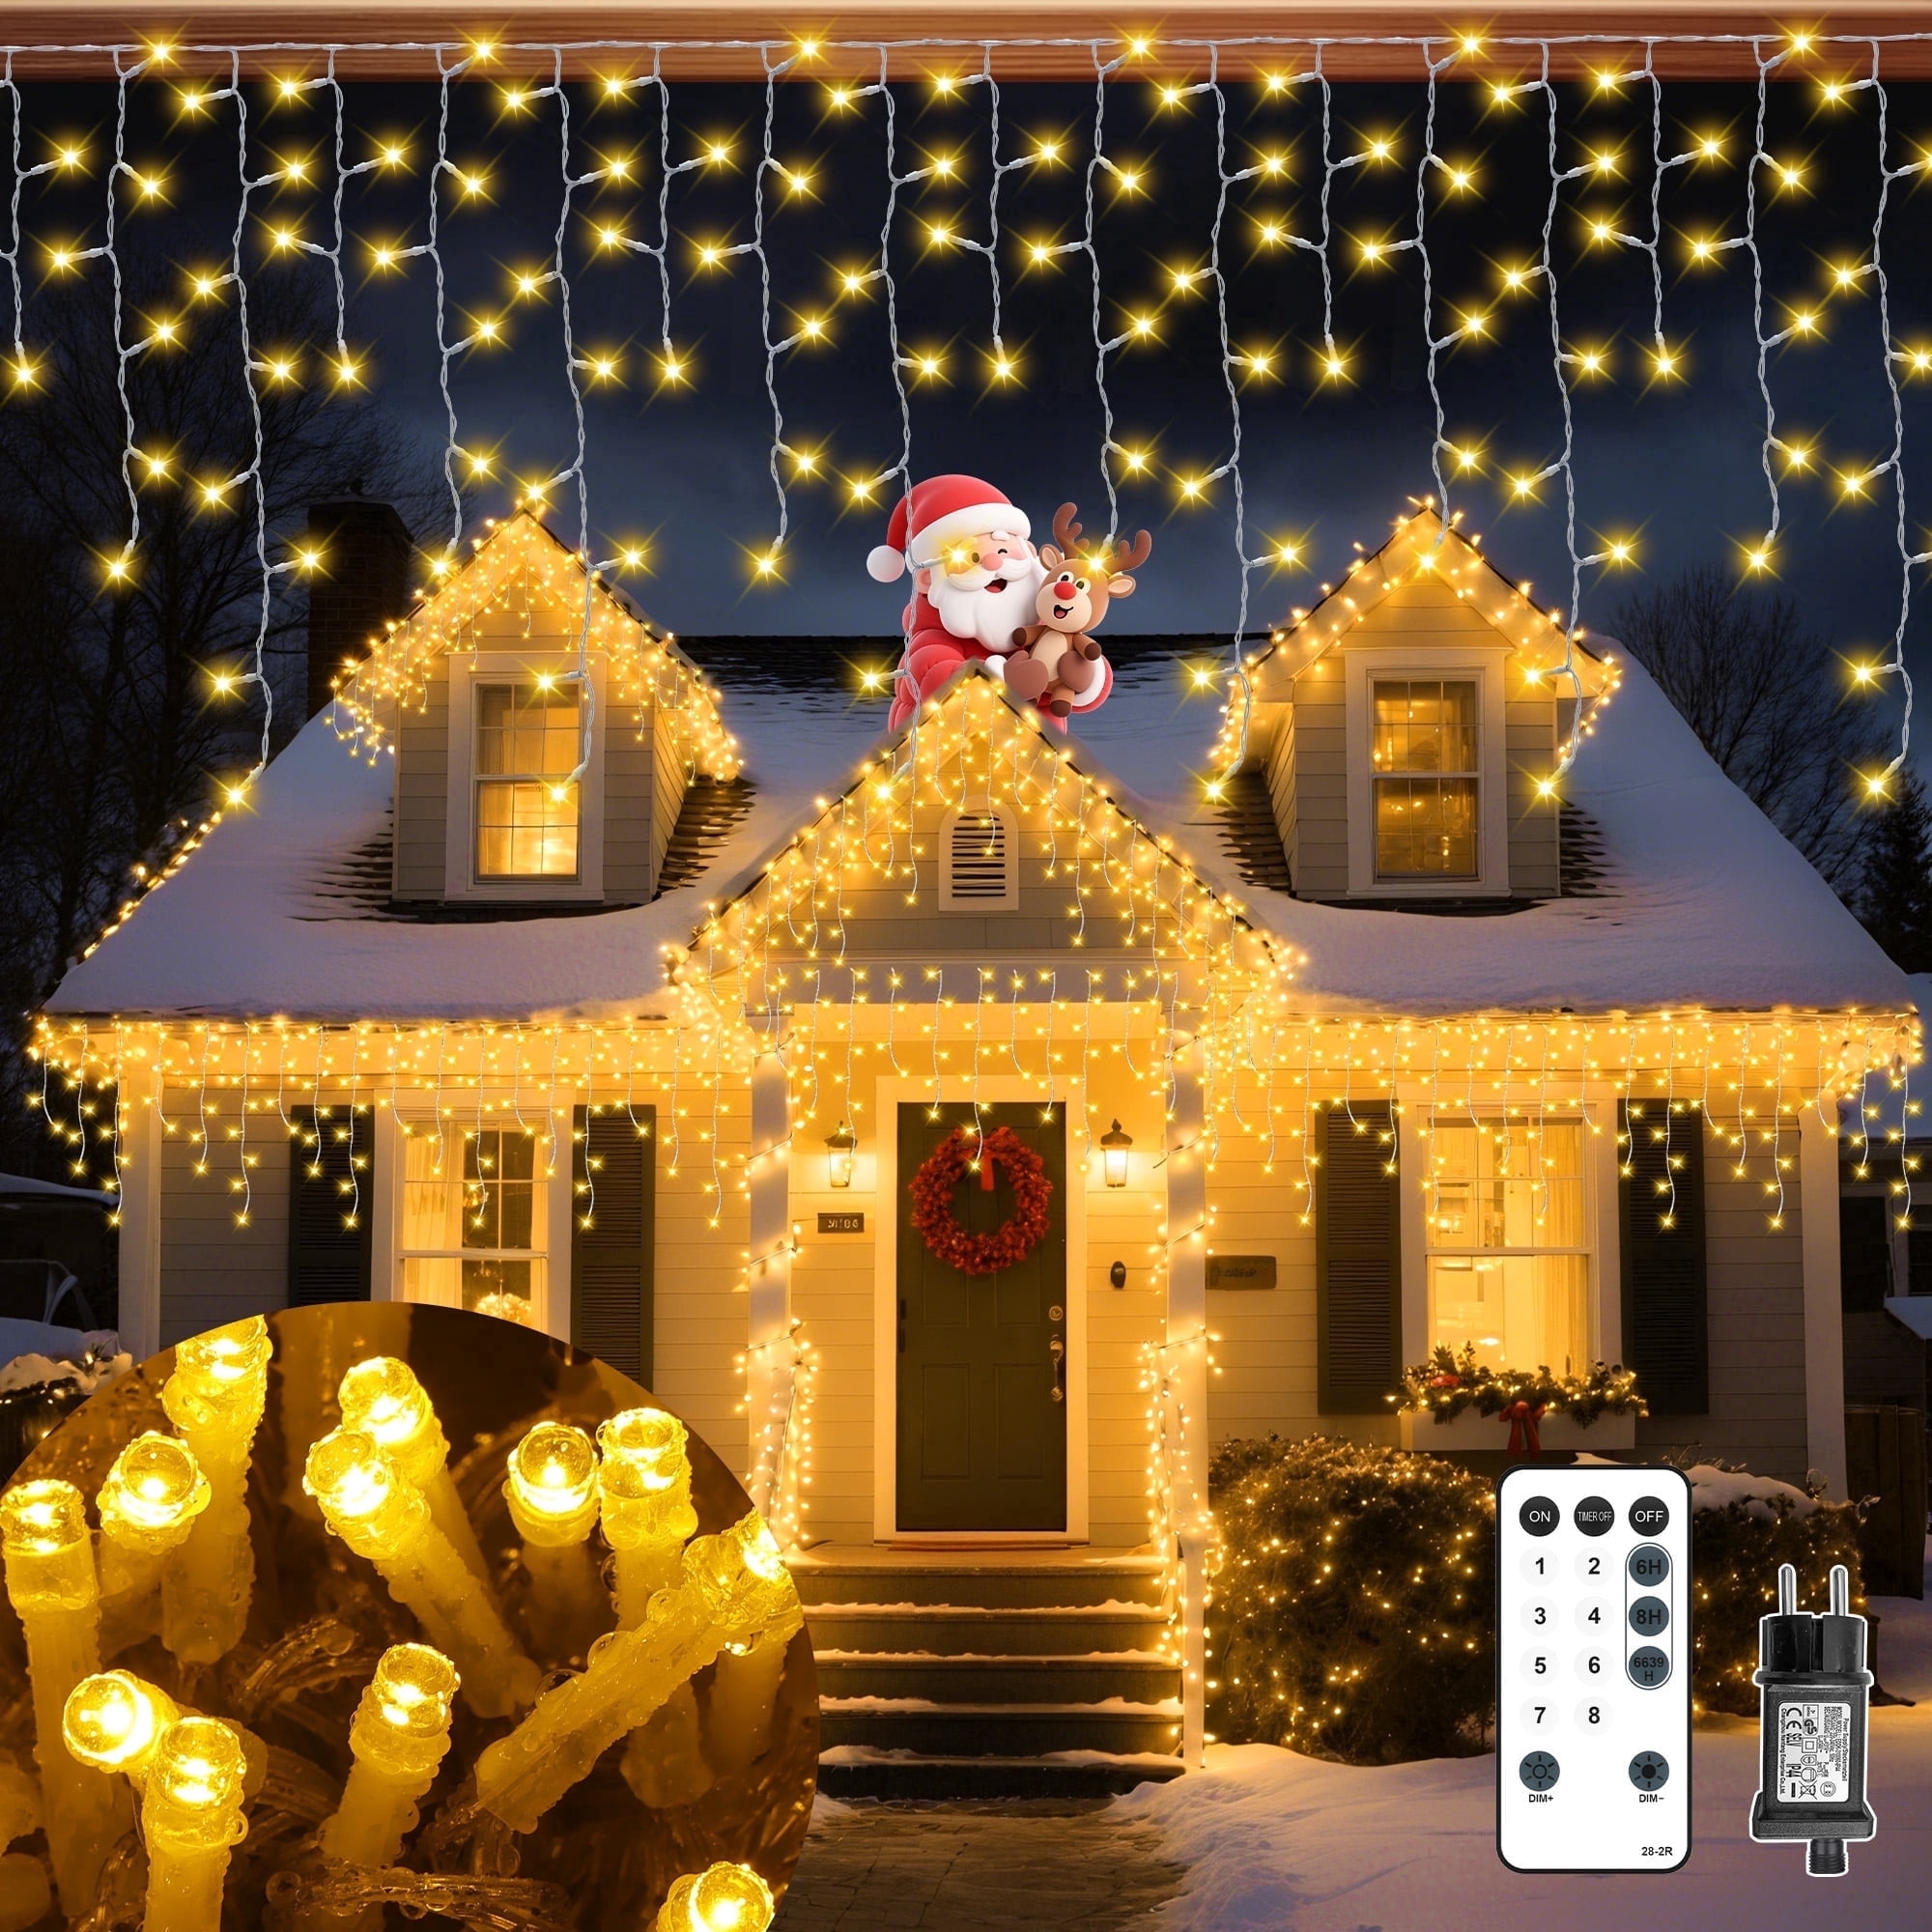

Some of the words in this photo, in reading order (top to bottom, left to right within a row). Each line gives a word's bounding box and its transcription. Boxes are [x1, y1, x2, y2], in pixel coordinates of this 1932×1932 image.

[1528, 1510, 1550, 1522] ON
[1577, 1511, 1598, 1522] TIMER
[1599, 1511, 1612, 1522] OFF
[1634, 1510, 1664, 1522] OFF
[1535, 1557, 1545, 1575] 1
[1589, 1556, 1600, 1575] 2
[1635, 1559, 1662, 1576] 6H
[1534, 1606, 1546, 1625] 3
[1588, 1606, 1601, 1625] 4
[1635, 1608, 1662, 1625] 8H
[1534, 1656, 1546, 1674] 5
[1588, 1656, 1600, 1674] 6
[1633, 1656, 1664, 1668] 6639
[1644, 1670, 1653, 1682] H
[1534, 1706, 1546, 1724] 7
[1588, 1706, 1600, 1724] 8
[1786, 1732, 1802, 1747] SELV
[1786, 1763, 1802, 1777] IP44
[1528, 1793, 1554, 1804] DIM+
[1641, 1846, 1673, 1857] 28-2R
